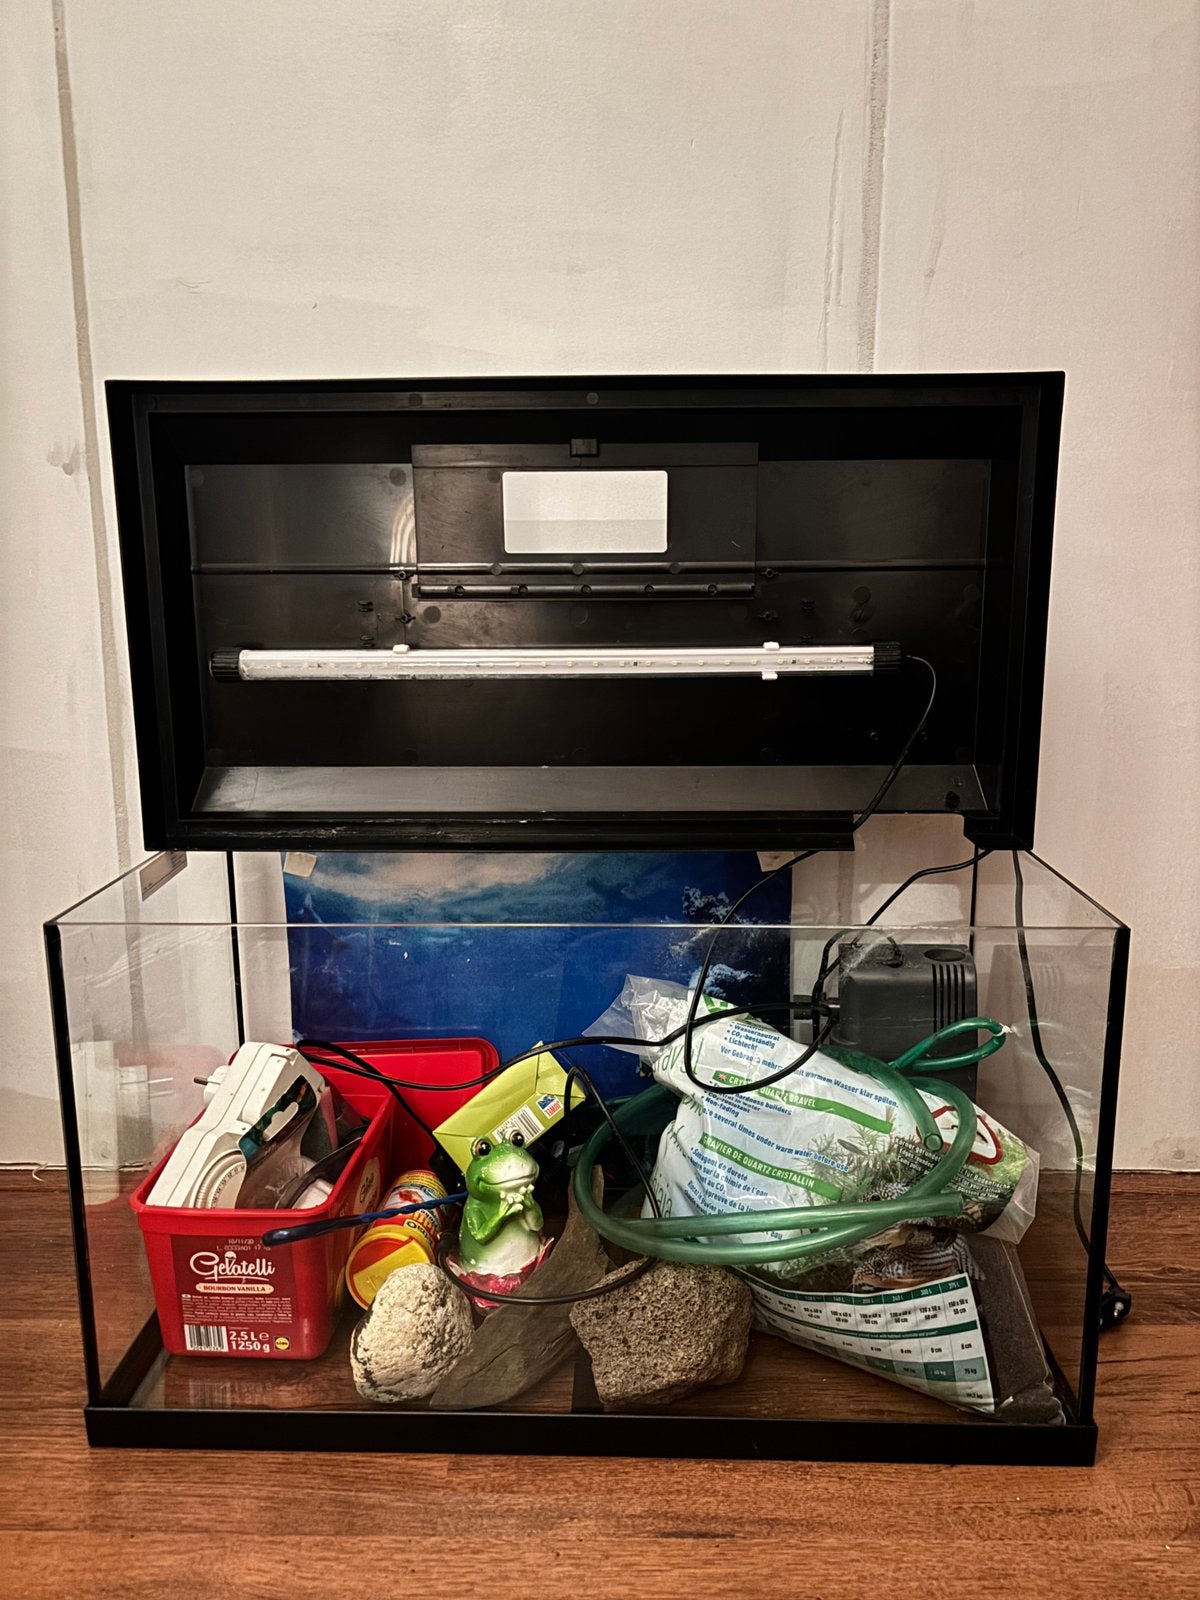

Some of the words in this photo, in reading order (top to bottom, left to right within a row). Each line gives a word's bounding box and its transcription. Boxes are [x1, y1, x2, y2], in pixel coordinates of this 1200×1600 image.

[728, 1037, 758, 1050] Lichtecht
[720, 1045, 731, 1055] Vor
[833, 1080, 859, 1093] Wasser
[859, 1088, 874, 1099] klar
[705, 1097, 740, 1118] Non-fading
[765, 1101, 792, 1115] builders
[789, 1093, 816, 1108] GRAVEL
[713, 1111, 737, 1128] several
[738, 1123, 756, 1138] times
[756, 1134, 777, 1147] under
[775, 1143, 793, 1154] warm
[795, 1147, 813, 1158] water
[813, 1153, 835, 1167] before
[836, 1162, 849, 1172] use
[727, 1165, 748, 1181] dureté
[733, 1151, 743, 1161] DE
[742, 1154, 772, 1175] QUARTZ
[771, 1167, 815, 1187] CRISTALLIN
[742, 1183, 751, 1193] de
[190, 1251, 276, 1282] Gelatelli
[231, 1341, 261, 1351] 1250
[263, 1343, 271, 1353] g
